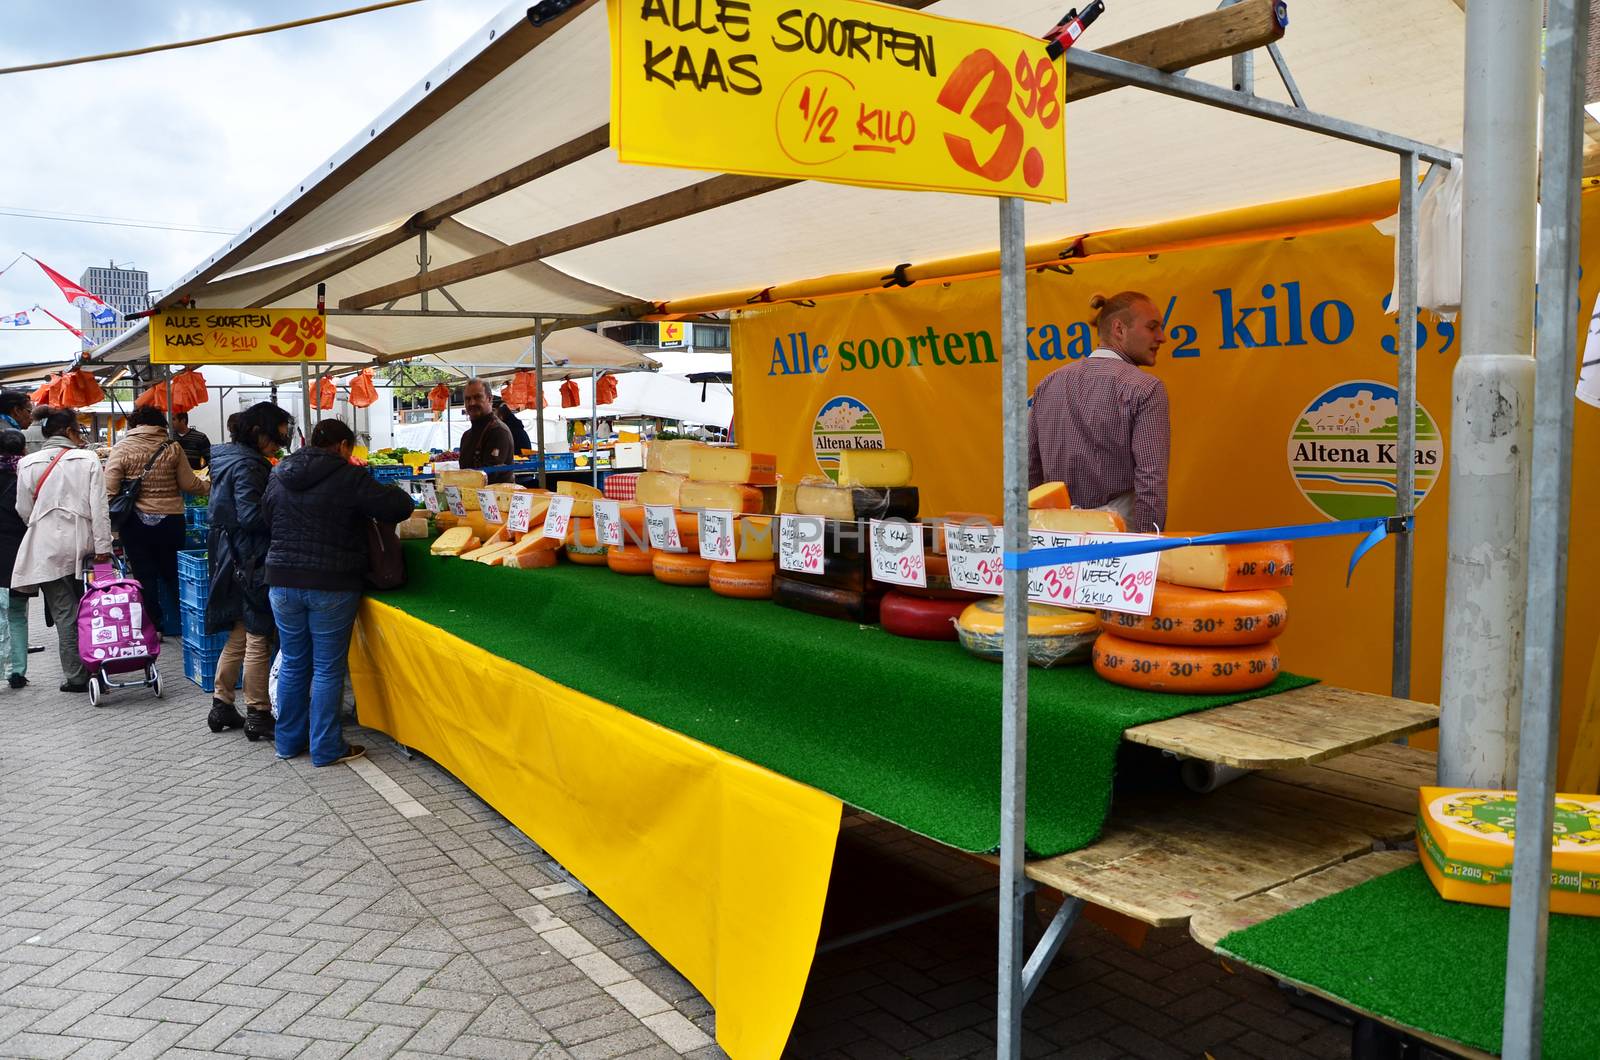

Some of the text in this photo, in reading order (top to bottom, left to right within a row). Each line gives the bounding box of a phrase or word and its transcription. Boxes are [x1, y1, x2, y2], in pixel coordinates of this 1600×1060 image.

[641, 0, 937, 77] ALLE SOORTEN
[643, 39, 762, 96] KAAS
[799, 86, 915, 146] 1/2 KILO
[165, 315, 271, 329] ALLE SOORTEN
[768, 331, 829, 376] Alle
[838, 326, 998, 371] soorten
[1214, 281, 1354, 350] kilo
[165, 333, 204, 347] KAAS
[232, 336, 258, 349] KILO
[816, 436, 882, 450] Altena Kaas
[1294, 442, 1437, 465] Altena Kas
[1092, 591, 1113, 603] KILO
[1151, 617, 1183, 632] 30+
[1193, 618, 1225, 633] 30+
[1233, 616, 1262, 631] 30+
[1103, 654, 1125, 669] 30+
[1131, 659, 1160, 674] 30+
[1169, 662, 1203, 677] 30+
[1212, 661, 1241, 676] 30+
[1249, 659, 1267, 674] 30+
[1462, 866, 1579, 886] 2015 2015
